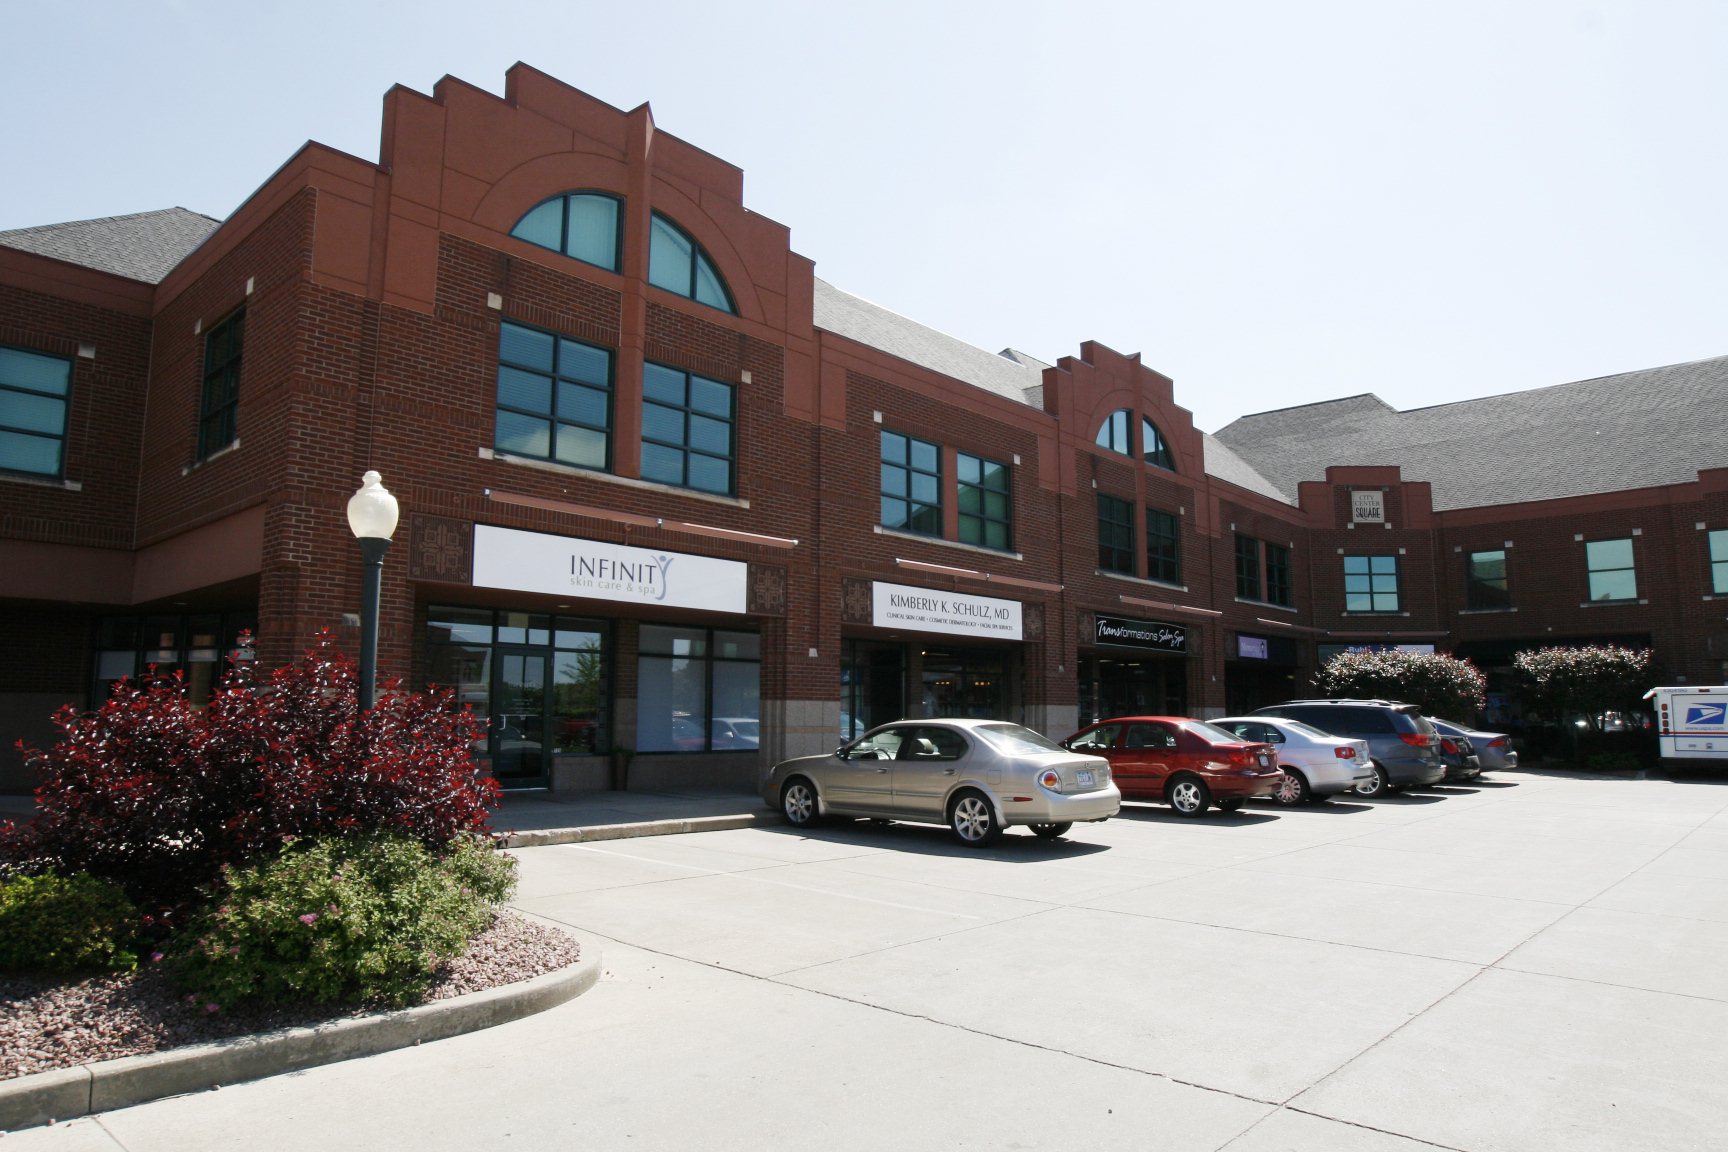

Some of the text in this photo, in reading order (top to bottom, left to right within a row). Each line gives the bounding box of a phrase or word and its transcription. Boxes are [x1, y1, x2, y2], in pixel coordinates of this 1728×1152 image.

[1356, 507, 1381, 520] SQUARE
[570, 575, 656, 596] skin care & spa
[571, 554, 675, 601] INFINITY
[886, 612, 905, 620] CLINICAL
[890, 594, 1010, 621] KIMBERLY K. SCHULZ, MD
[1097, 620, 1158, 641] Transformations
